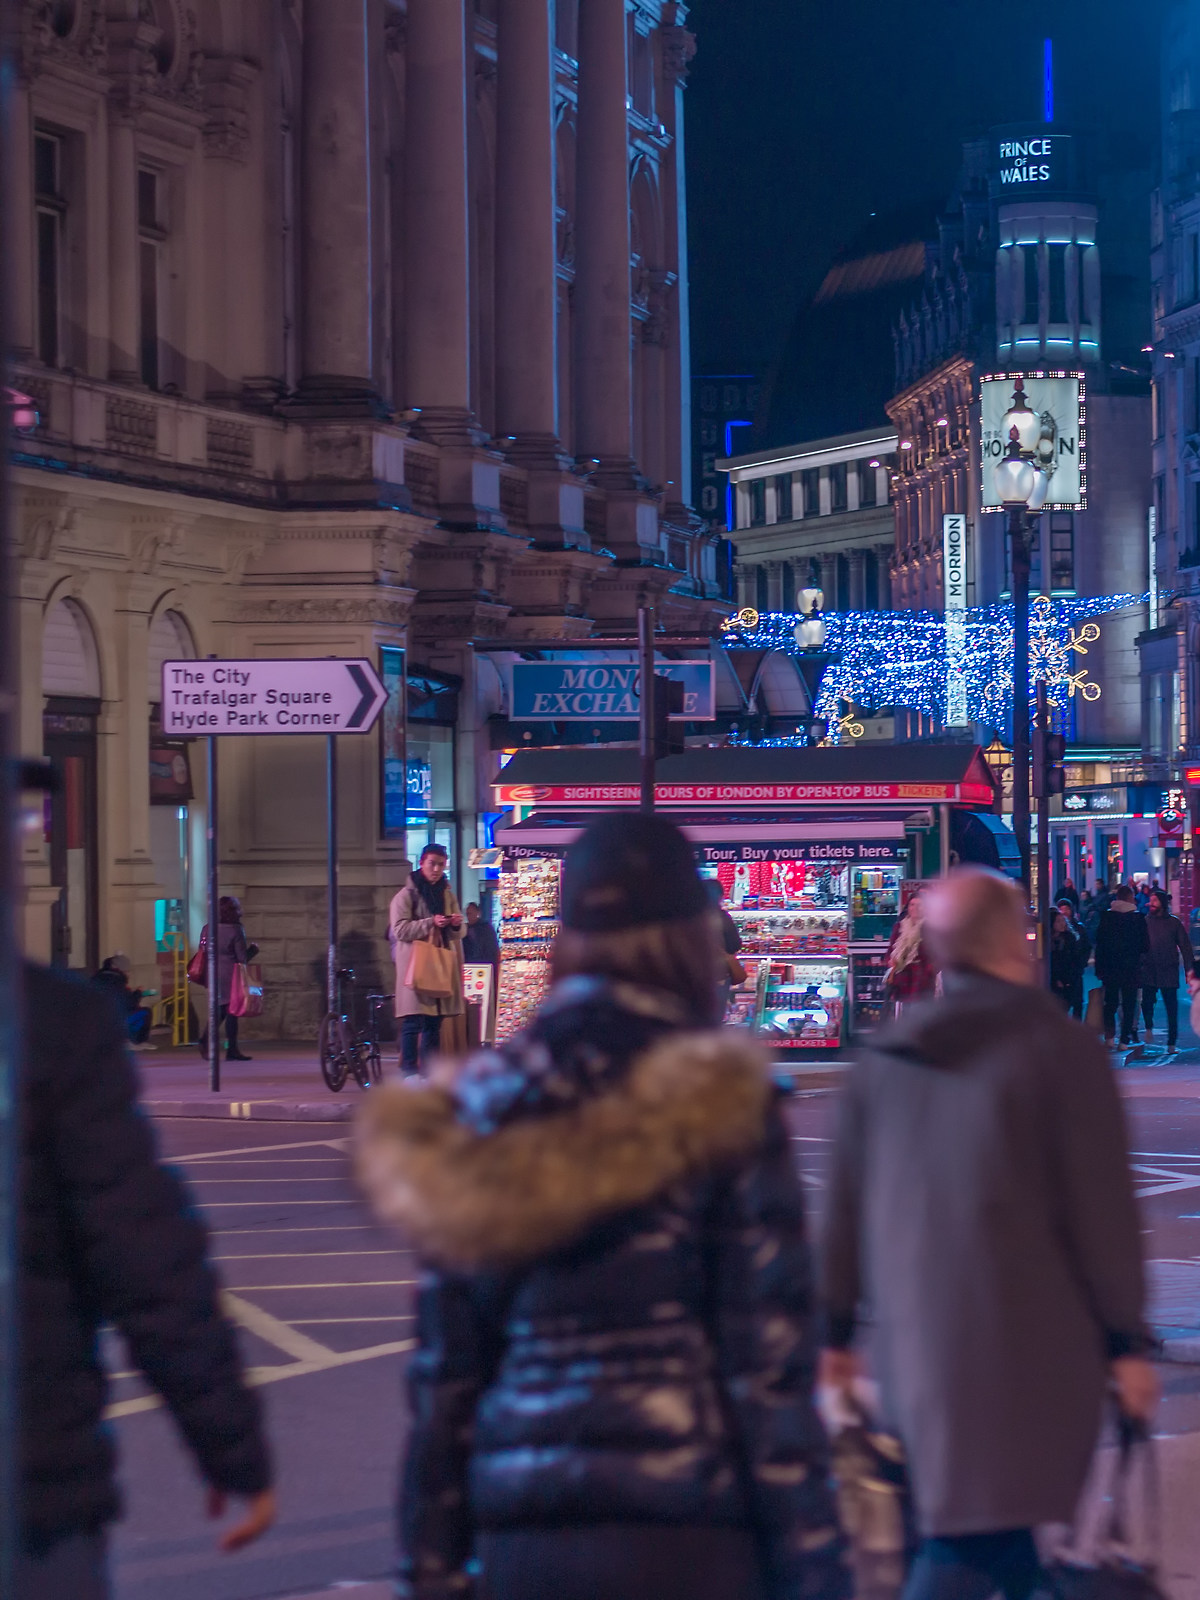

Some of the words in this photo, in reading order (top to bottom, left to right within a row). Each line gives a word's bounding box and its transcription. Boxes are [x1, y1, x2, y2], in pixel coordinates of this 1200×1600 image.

[1000, 139, 1052, 158] PRINCE
[1014, 157, 1028, 167] OF
[1000, 165, 1050, 184] WALES
[949, 517, 962, 597] MORMON
[171, 669, 205, 684] The
[213, 668, 251, 686] City
[559, 668, 673, 689] MON
[171, 690, 257, 707] Trafalgar
[265, 689, 333, 707] Square
[531, 693, 699, 714] EXCHAE
[171, 711, 218, 729] Hyde
[226, 710, 269, 725] Park
[276, 710, 341, 725] Corner
[564, 786, 642, 799] SIGHTSEEIN
[654, 787, 694, 799] OURS
[696, 787, 715, 799] OF
[716, 786, 775, 799] LONDON
[777, 786, 791, 798] BY
[793, 786, 861, 798] OPEN-TOP
[864, 786, 890, 797] BUS
[902, 784, 943, 797] TICKETS
[507, 845, 558, 859] Hop-on
[704, 847, 738, 862] Tour,
[742, 846, 768, 861] Buy
[772, 847, 805, 861] your
[809, 845, 855, 858] tickets
[859, 844, 893, 858] here.
[792, 1039, 827, 1047] TICKETS
